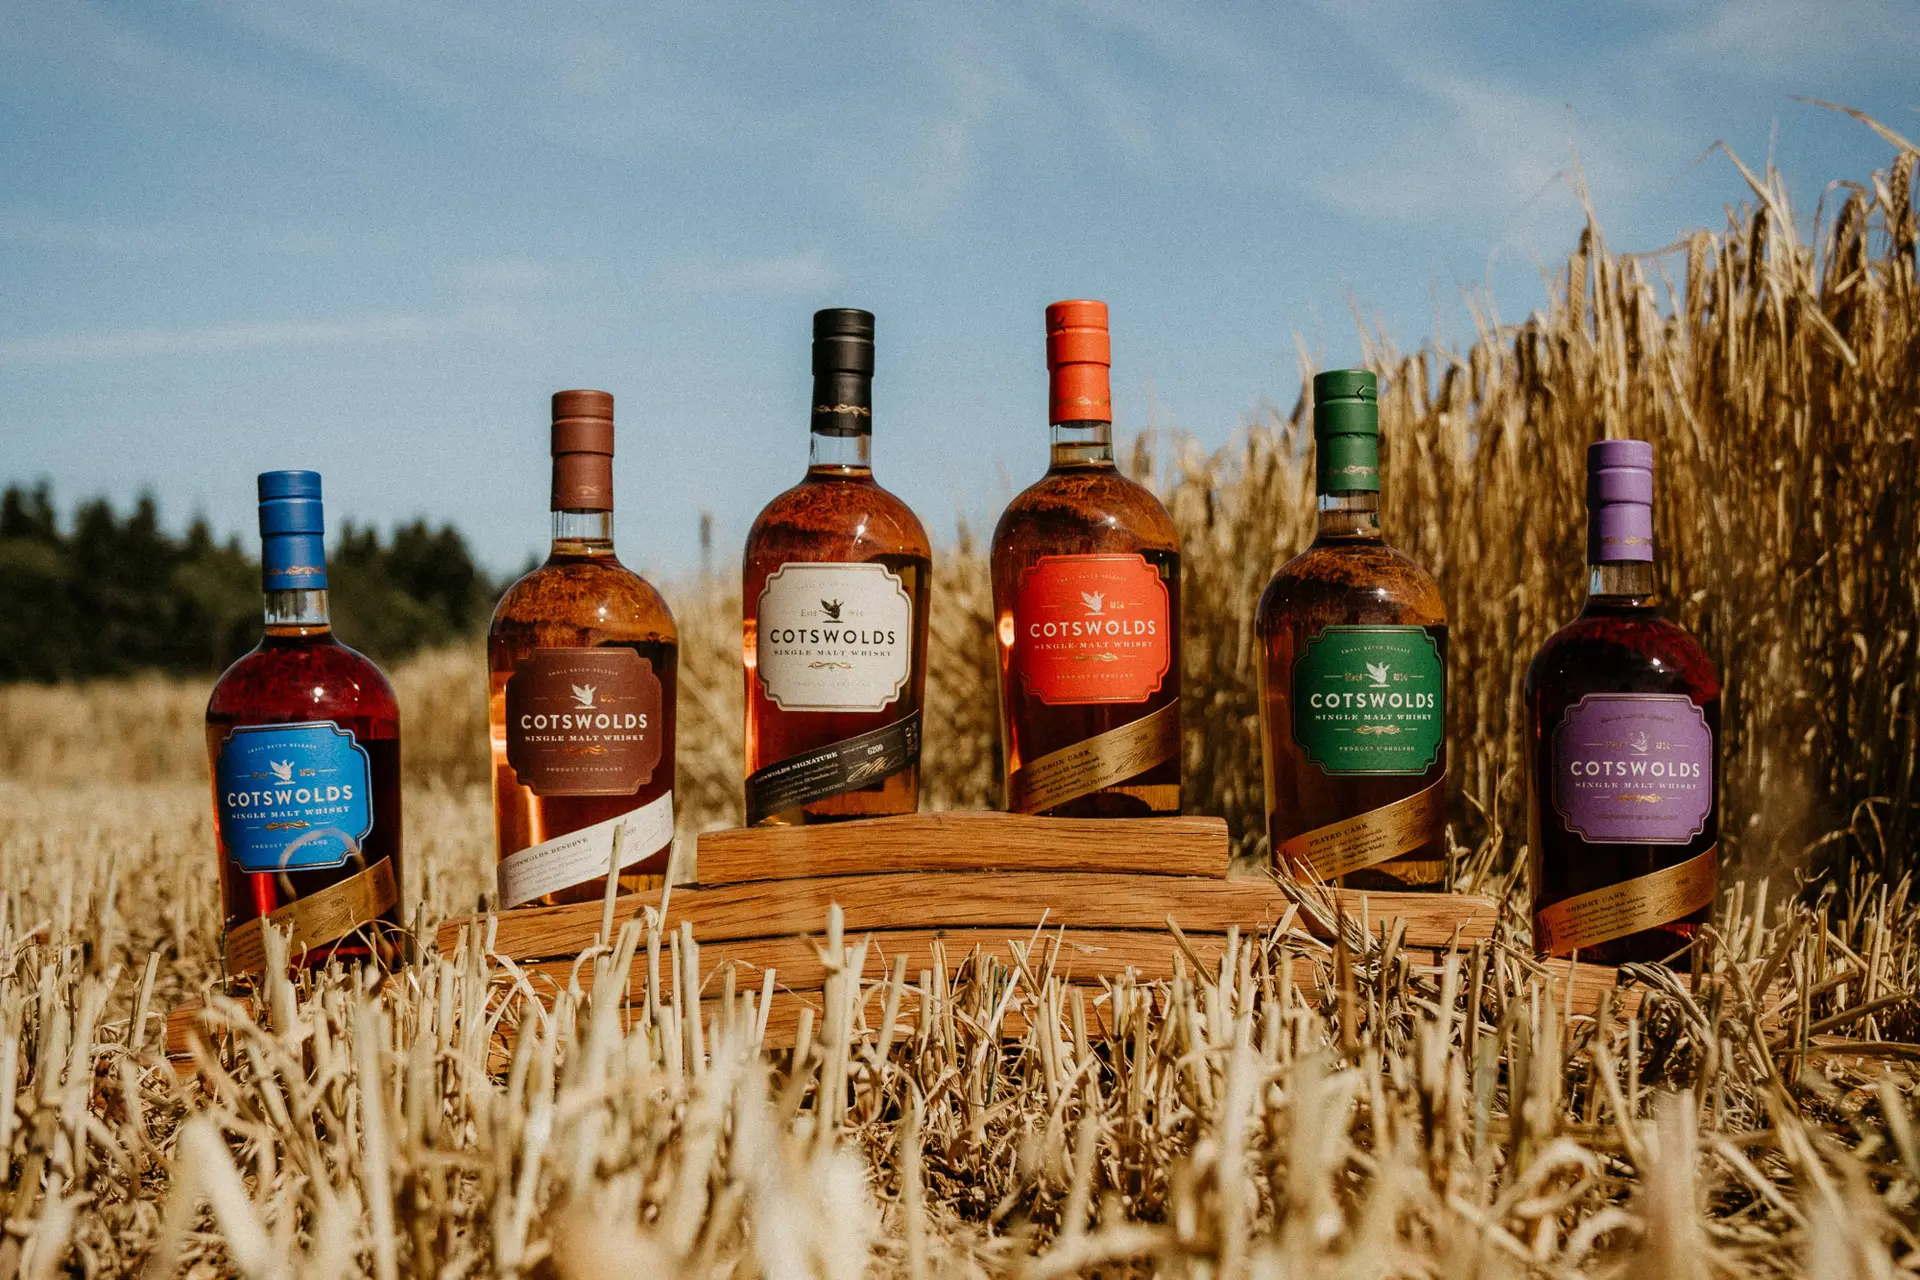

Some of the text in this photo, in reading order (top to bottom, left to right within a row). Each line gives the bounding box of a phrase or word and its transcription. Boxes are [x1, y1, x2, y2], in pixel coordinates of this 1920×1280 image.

[770, 629, 896, 645] COTSWOLDS
[1030, 619, 1156, 638] COTSWOLDS
[1310, 693, 1434, 709] COTSWOLDS
[521, 713, 648, 730] COTSWOLDS
[792, 751, 838, 770] SIGNATURE
[1067, 749, 1091, 764] CASK
[1570, 761, 1700, 778] COTSWOLDS
[1575, 781, 1618, 789] SINGLE
[227, 785, 353, 807] COTSWOLDS
[232, 805, 350, 820] SINGLE MALT WHISKY
[1308, 823, 1368, 847] PEATED CASK
[551, 837, 589, 854] RESERVE
